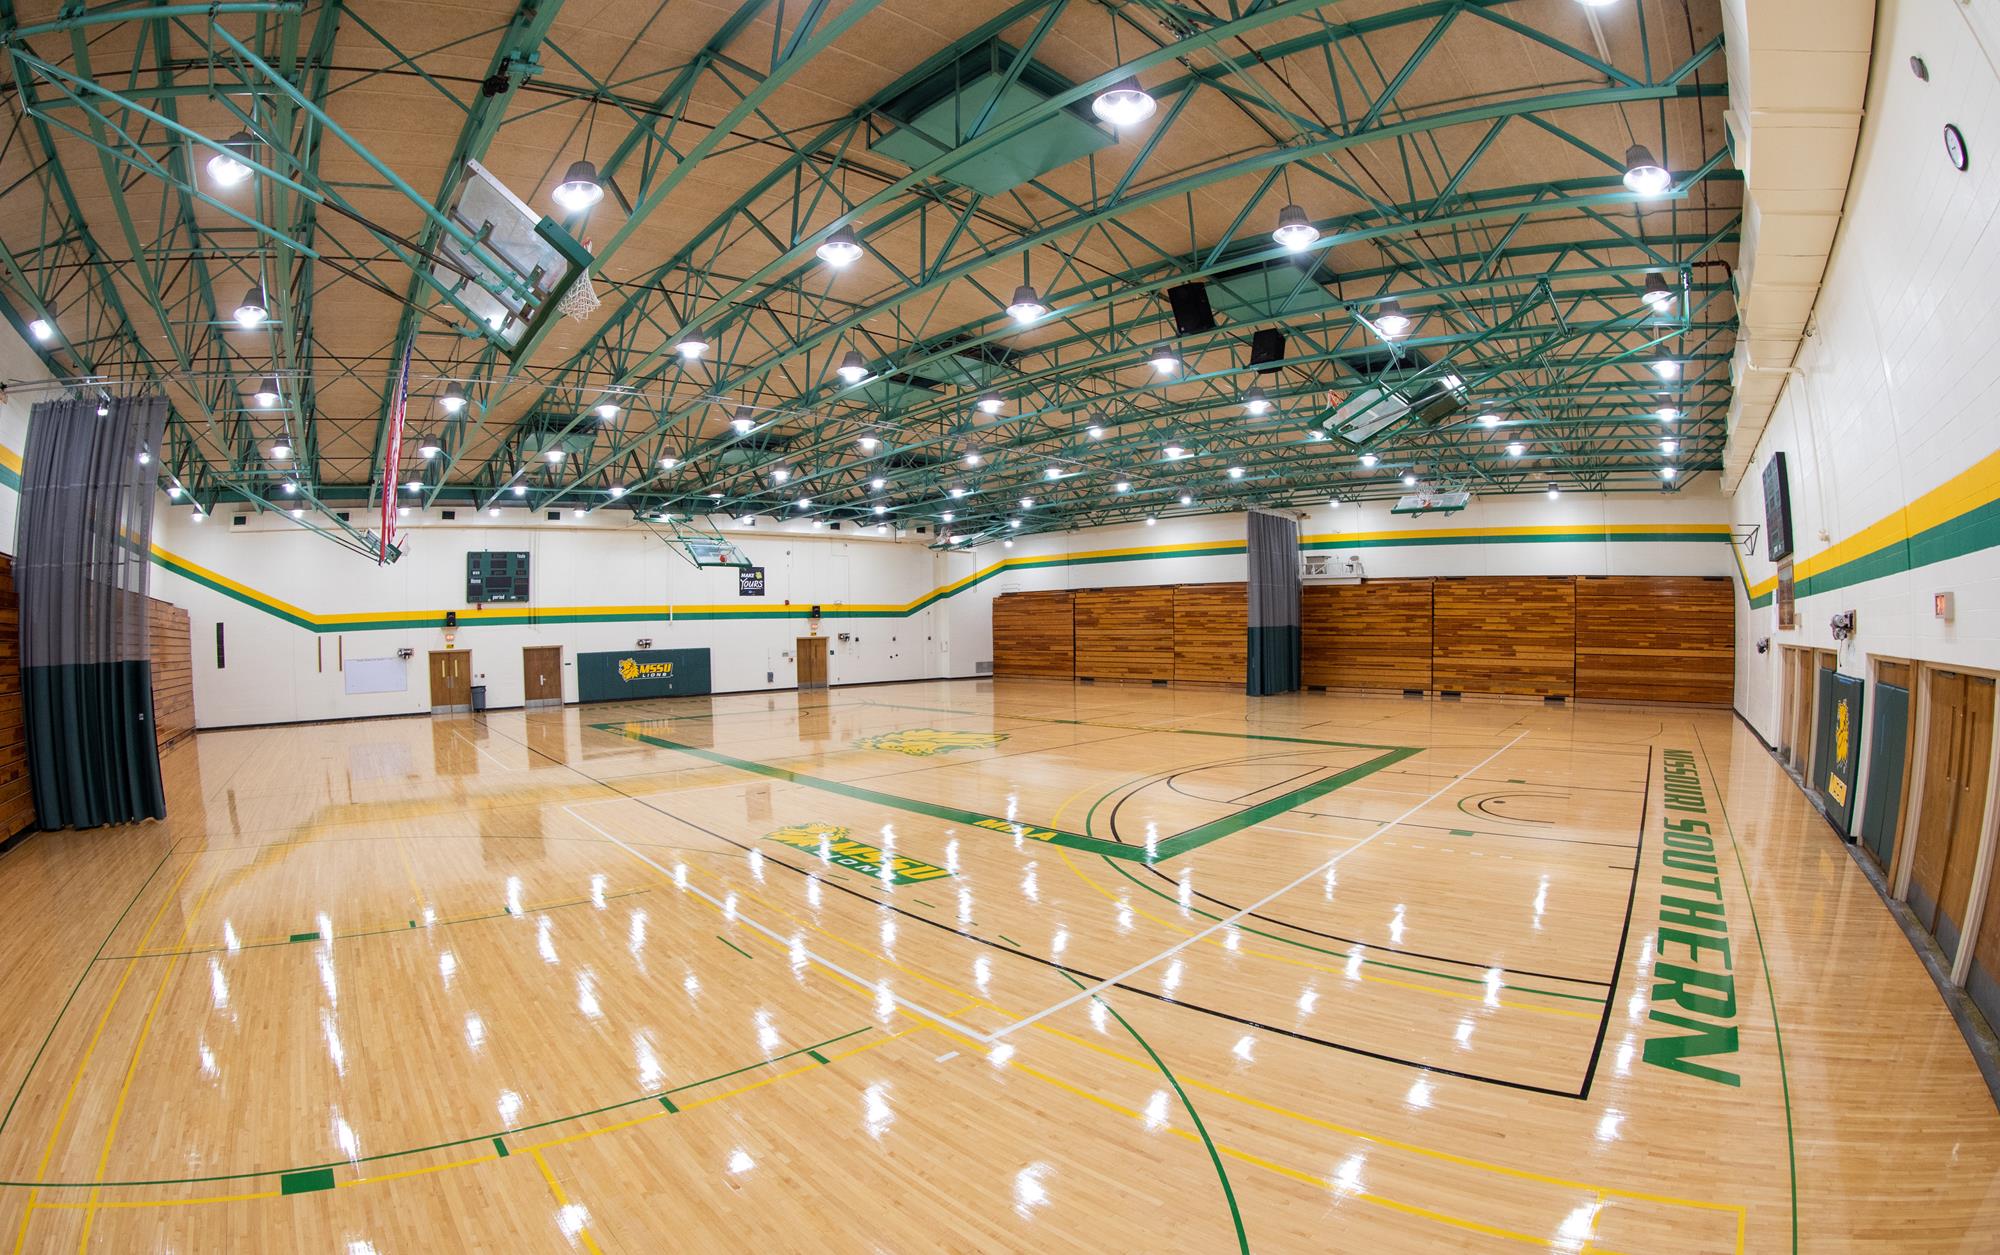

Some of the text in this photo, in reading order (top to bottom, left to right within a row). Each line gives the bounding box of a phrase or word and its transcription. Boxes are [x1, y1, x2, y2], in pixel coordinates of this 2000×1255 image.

[640, 663, 671, 674] MSSU
[1642, 748, 1741, 1087] MISSOURI SOUTHERN
